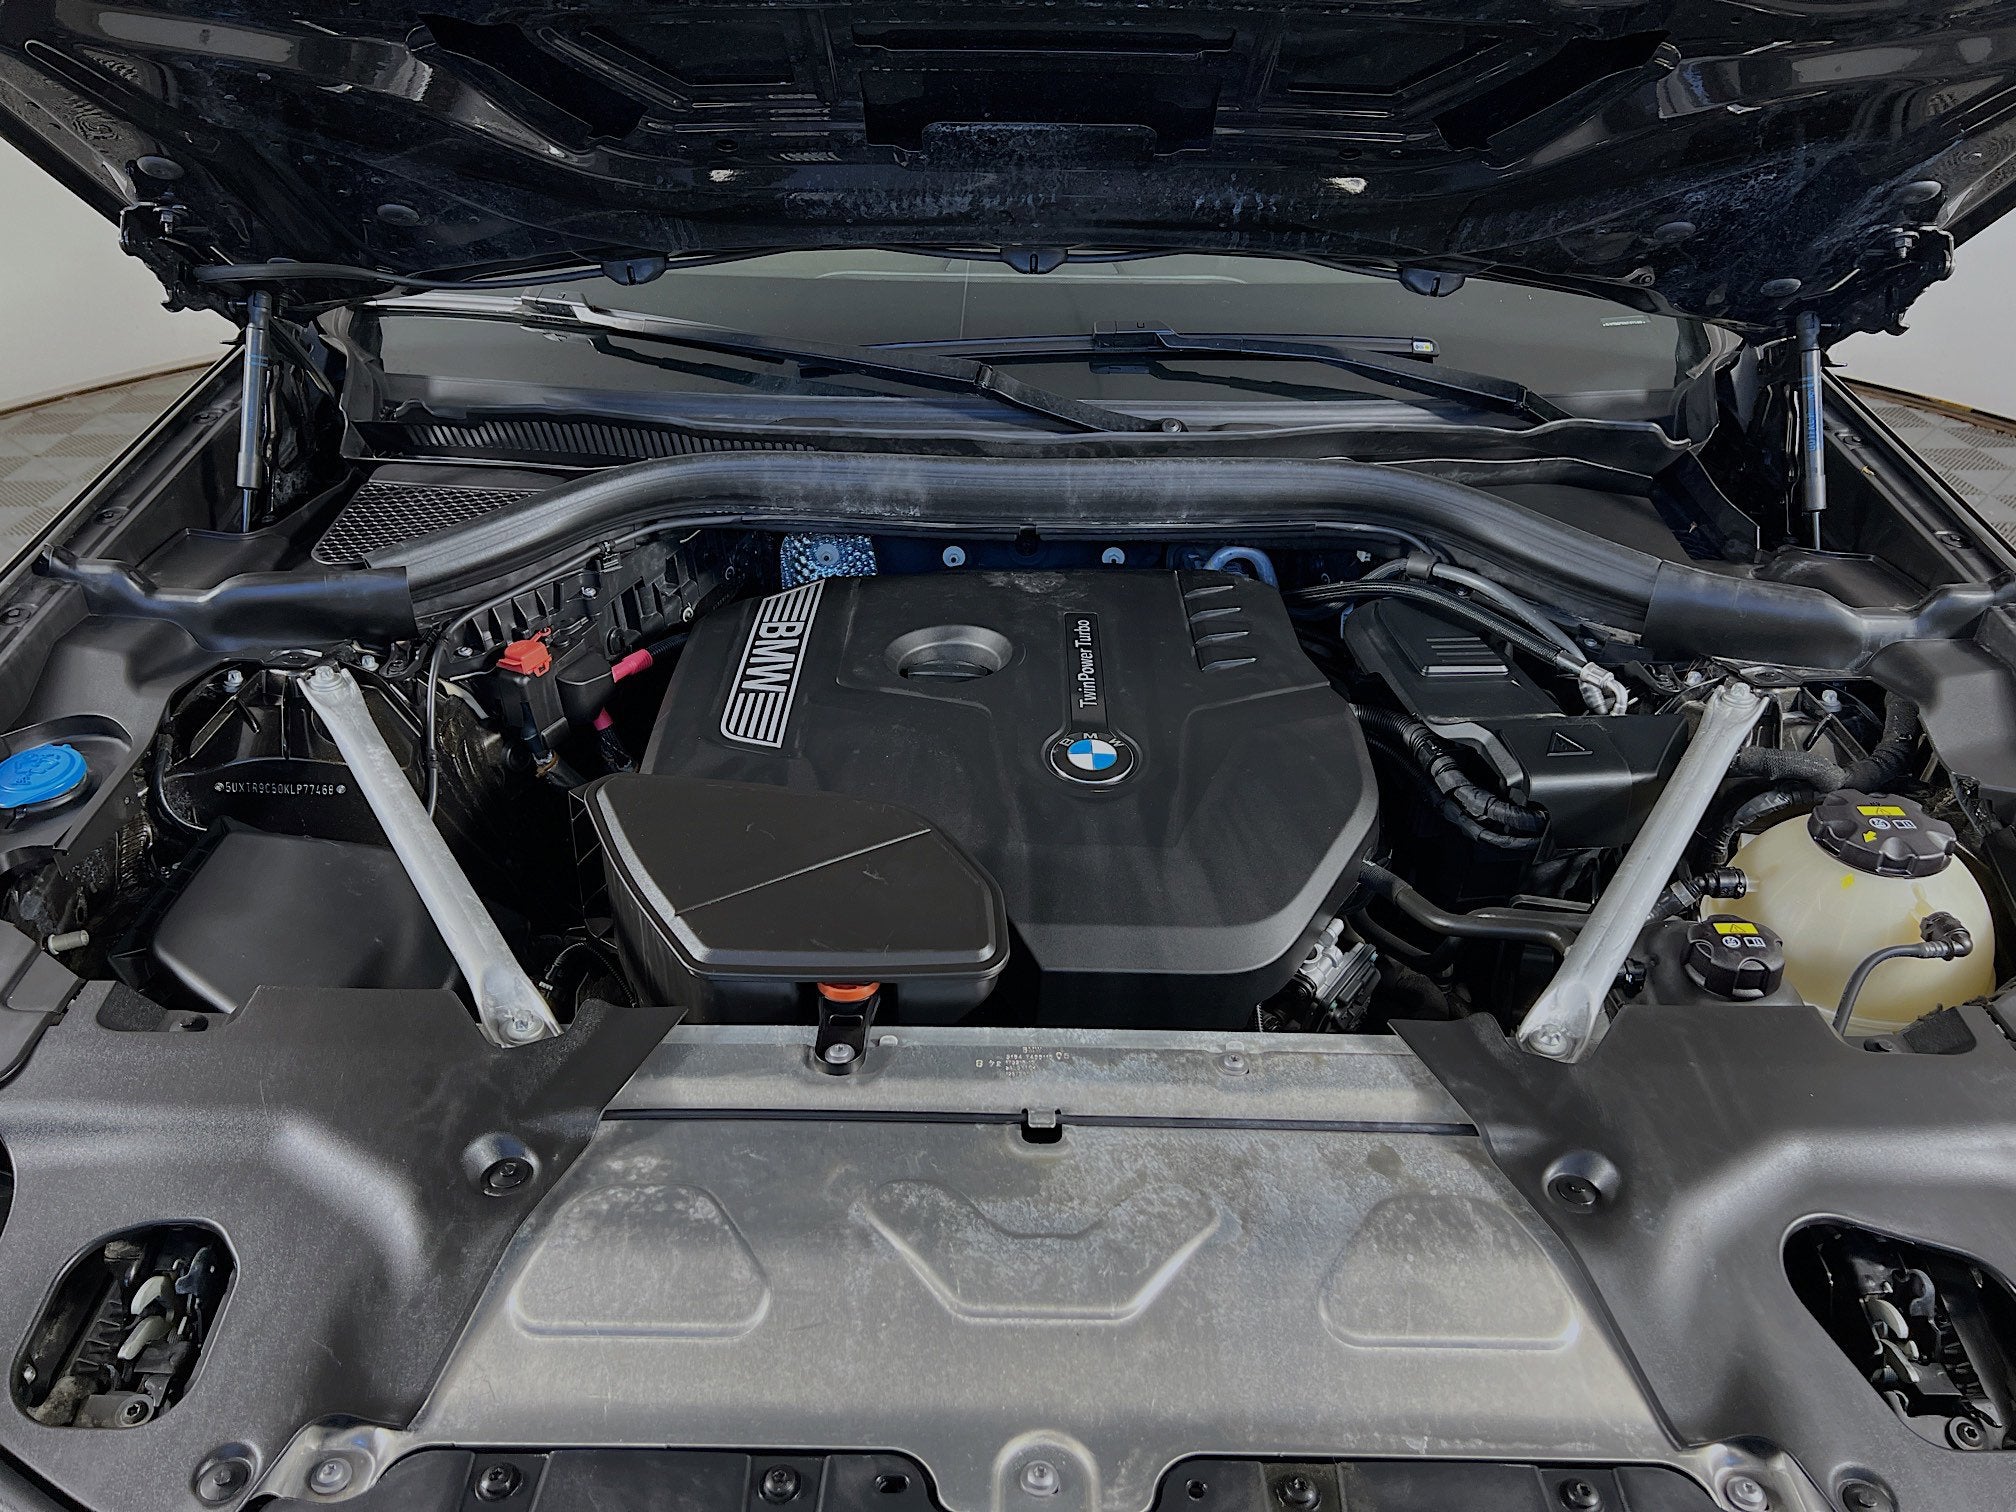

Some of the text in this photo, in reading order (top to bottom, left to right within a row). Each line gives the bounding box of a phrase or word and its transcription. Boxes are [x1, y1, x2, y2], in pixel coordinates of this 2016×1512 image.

[741, 621, 805, 693] BMW
[1074, 619, 1097, 708] TwinPower Turbo
[1059, 732, 1125, 747] BMW
[225, 781, 334, 795] 5UXTR9C50KLP77468
